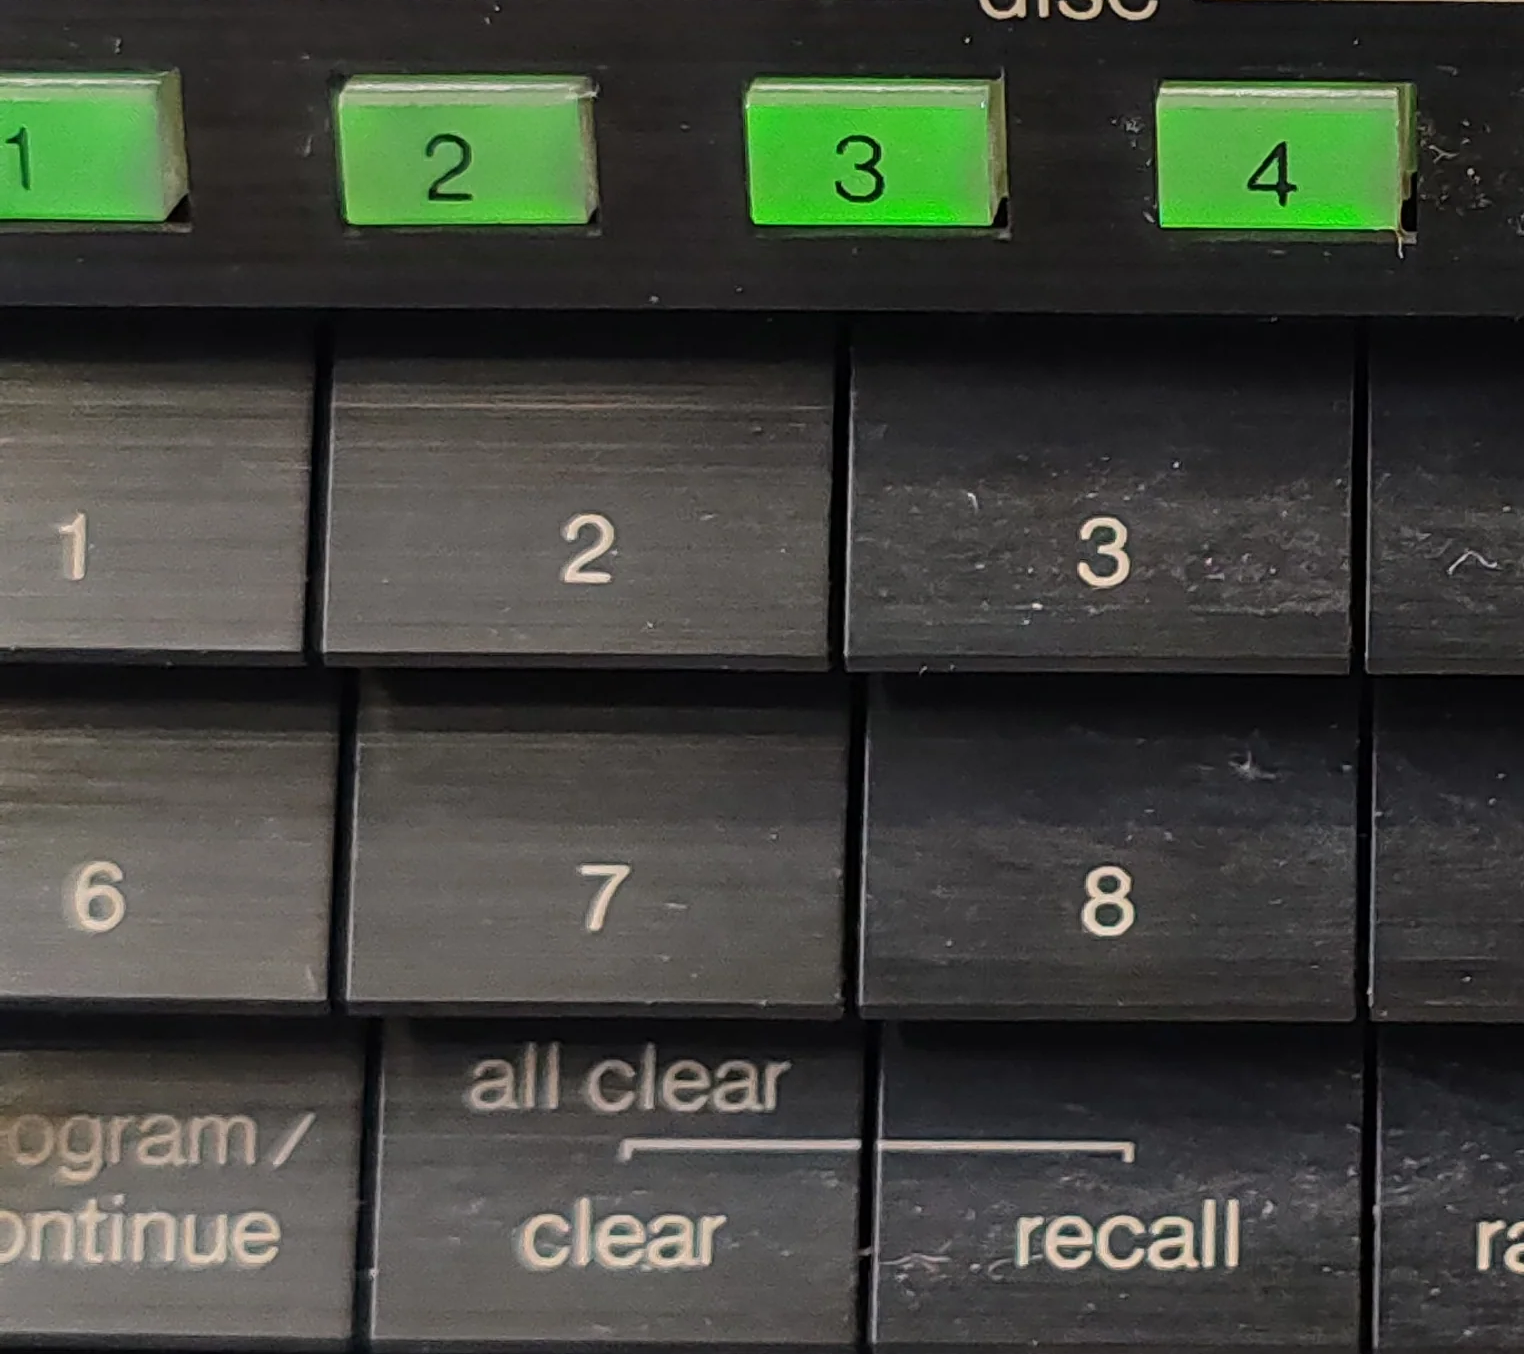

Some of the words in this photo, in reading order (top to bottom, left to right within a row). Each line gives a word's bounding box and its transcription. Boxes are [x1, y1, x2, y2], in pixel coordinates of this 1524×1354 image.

[4, 125, 31, 191] 1
[425, 133, 474, 202] 2
[834, 135, 885, 203] 3
[1246, 141, 1298, 207] 4
[57, 513, 89, 582] 1
[560, 513, 616, 584] 2
[1076, 516, 1132, 589] 3
[72, 861, 126, 933] 6
[577, 863, 632, 931] 7
[1080, 865, 1136, 937] 8
[468, 1043, 562, 1112] all
[586, 1043, 792, 1113] clear
[0, 1111, 318, 1185] ogram/
[518, 1196, 728, 1270] clear
[1014, 1198, 1241, 1271] recall
